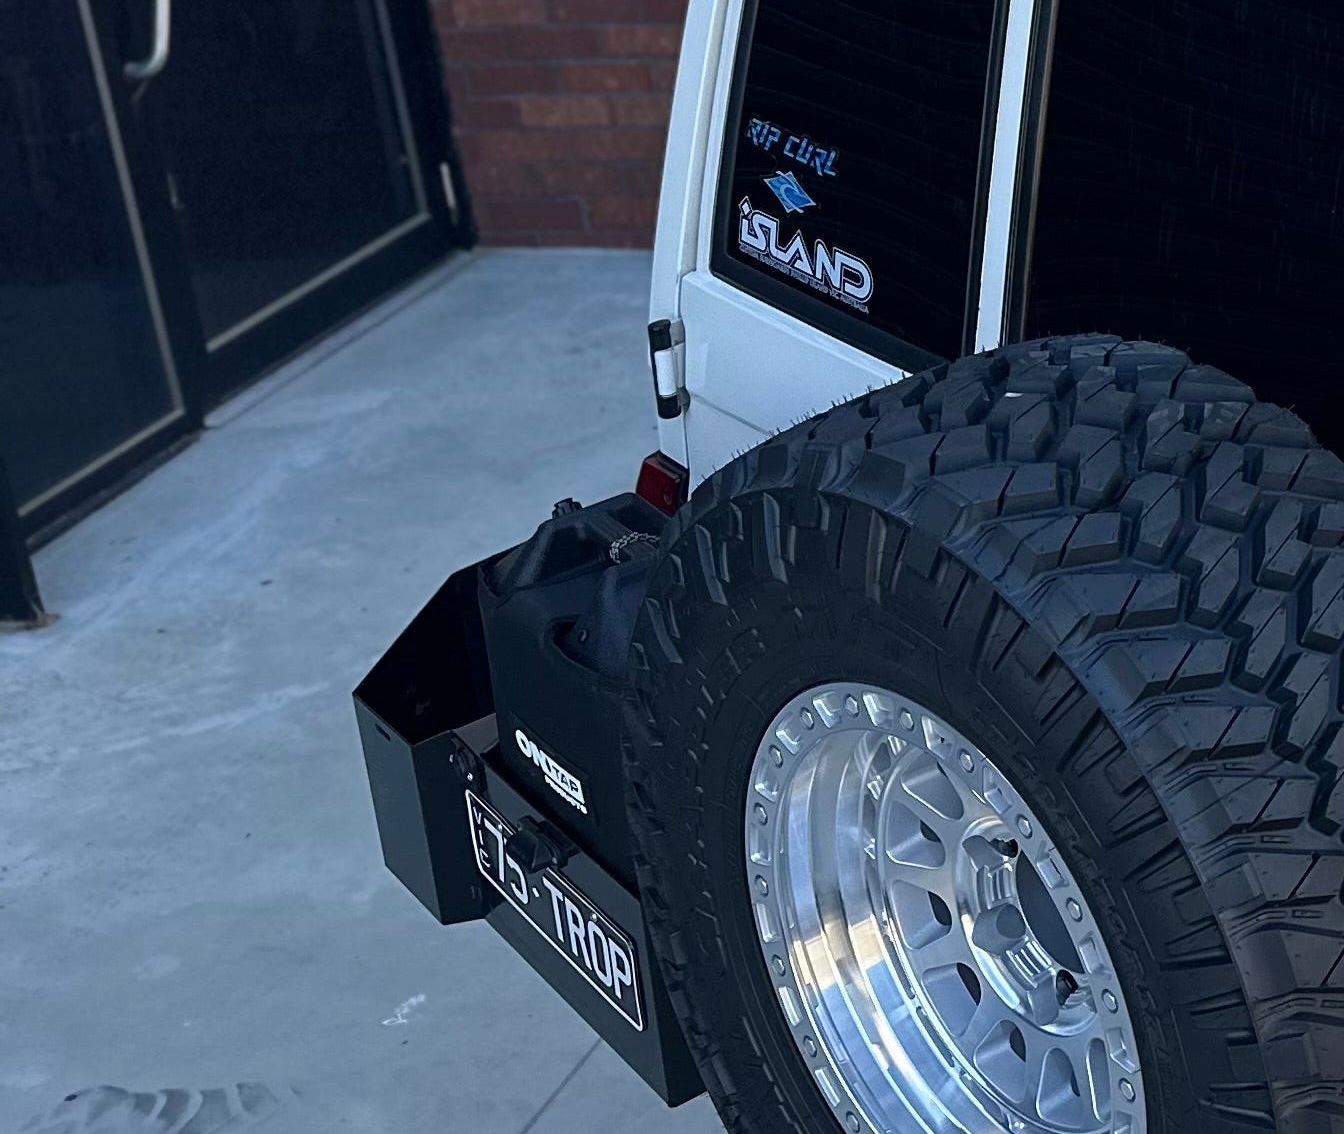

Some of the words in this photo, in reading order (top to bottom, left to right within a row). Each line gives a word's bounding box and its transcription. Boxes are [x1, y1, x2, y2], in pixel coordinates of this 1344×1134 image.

[747, 117, 782, 151] RIP
[783, 135, 838, 176] CURL
[473, 806, 491, 868] VIC
